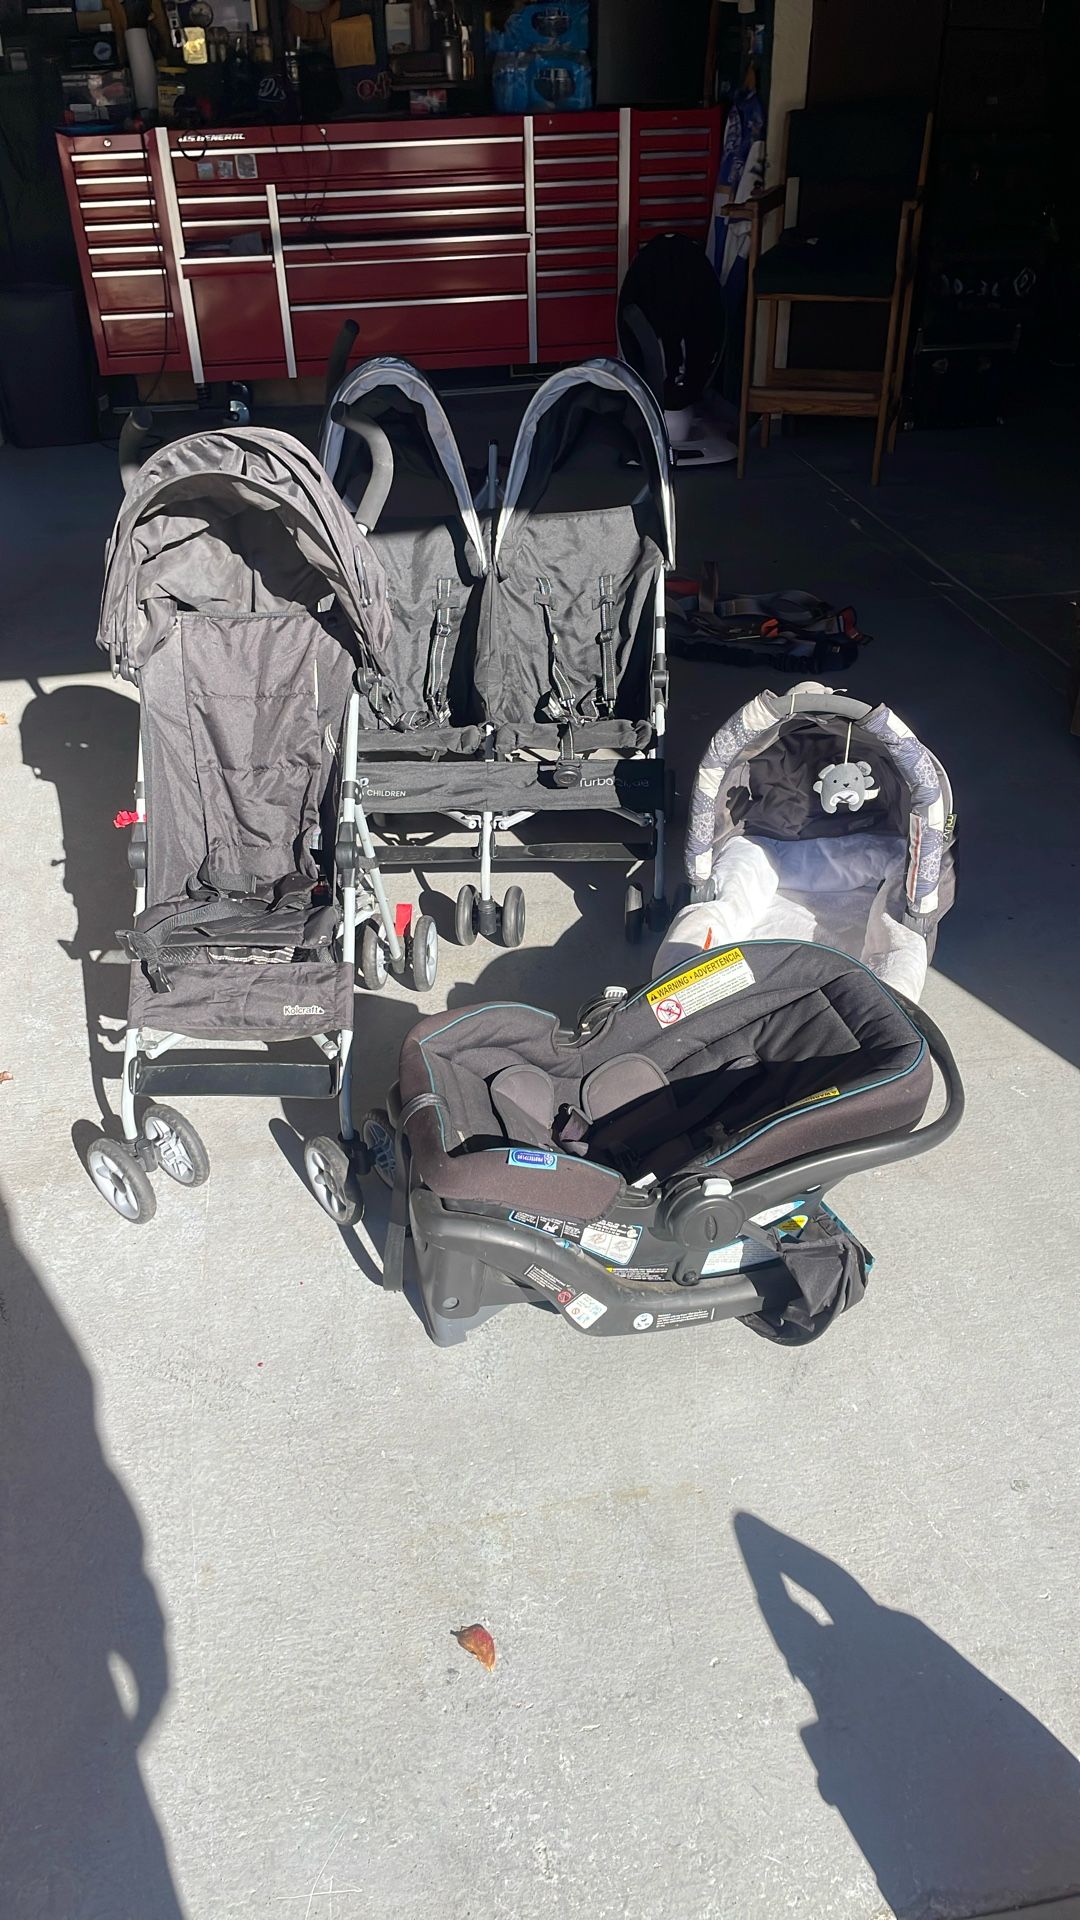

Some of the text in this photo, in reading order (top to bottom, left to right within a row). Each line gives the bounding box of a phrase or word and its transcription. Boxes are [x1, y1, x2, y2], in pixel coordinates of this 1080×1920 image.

[366, 789, 407, 798] CHILDREN
[657, 950, 741, 998] WARNING ADVERTENCIA
[283, 1005, 318, 1016] Kolcraft
